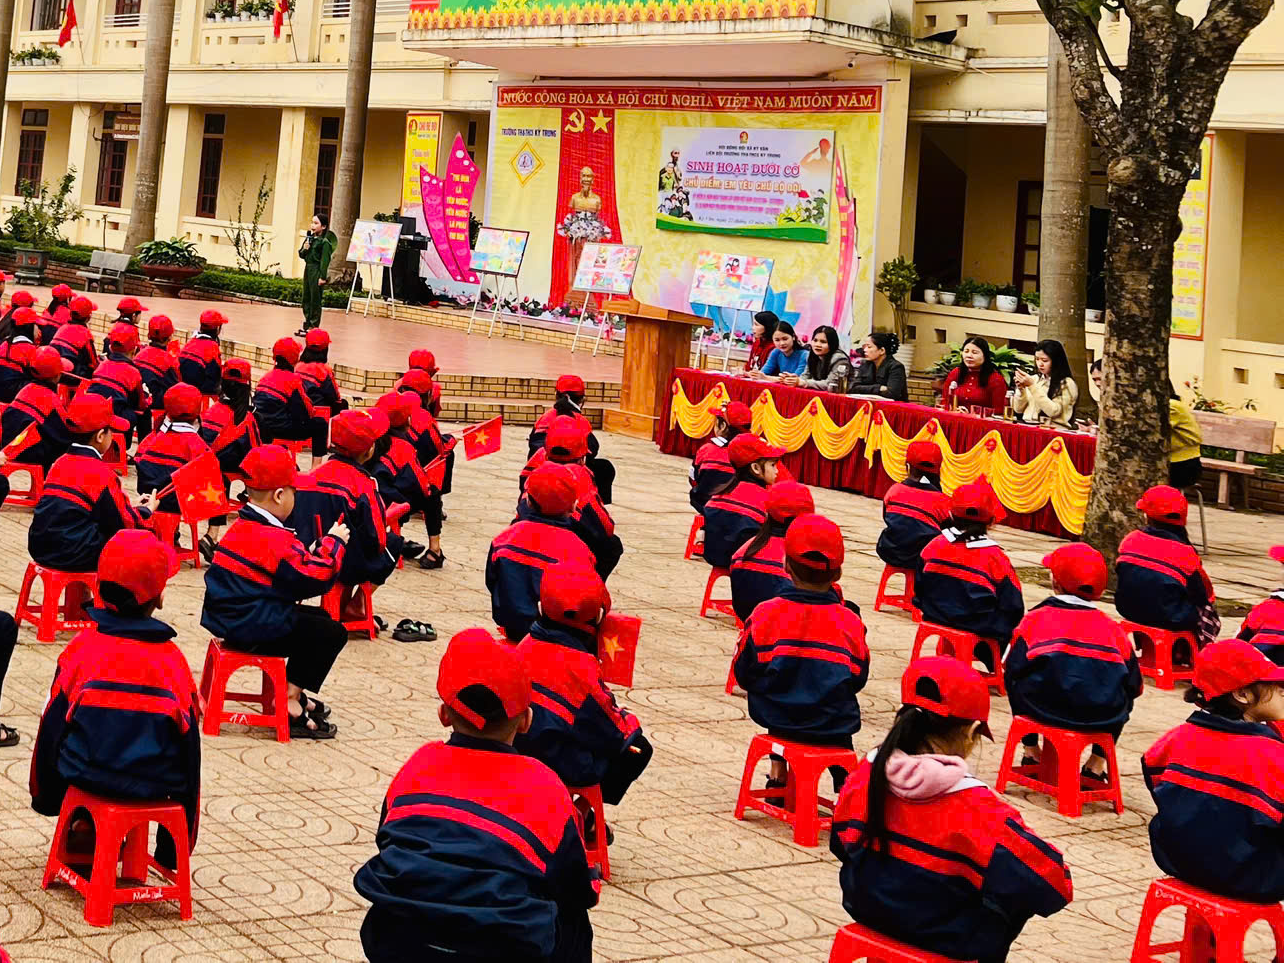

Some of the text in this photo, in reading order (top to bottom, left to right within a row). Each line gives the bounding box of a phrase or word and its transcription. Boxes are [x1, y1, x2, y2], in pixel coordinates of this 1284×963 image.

[503, 89, 873, 110] NƯỚC CỘNG HÒA XÃ HỘI CHỦ NGHĨA VIỆT NAM MUÔN NĂM
[543, 129, 556, 137] TRUNG
[686, 161, 714, 173] SINH
[716, 162, 749, 177] HOẠT
[724, 180, 736, 190] EM
[739, 179, 753, 191] YÊU
